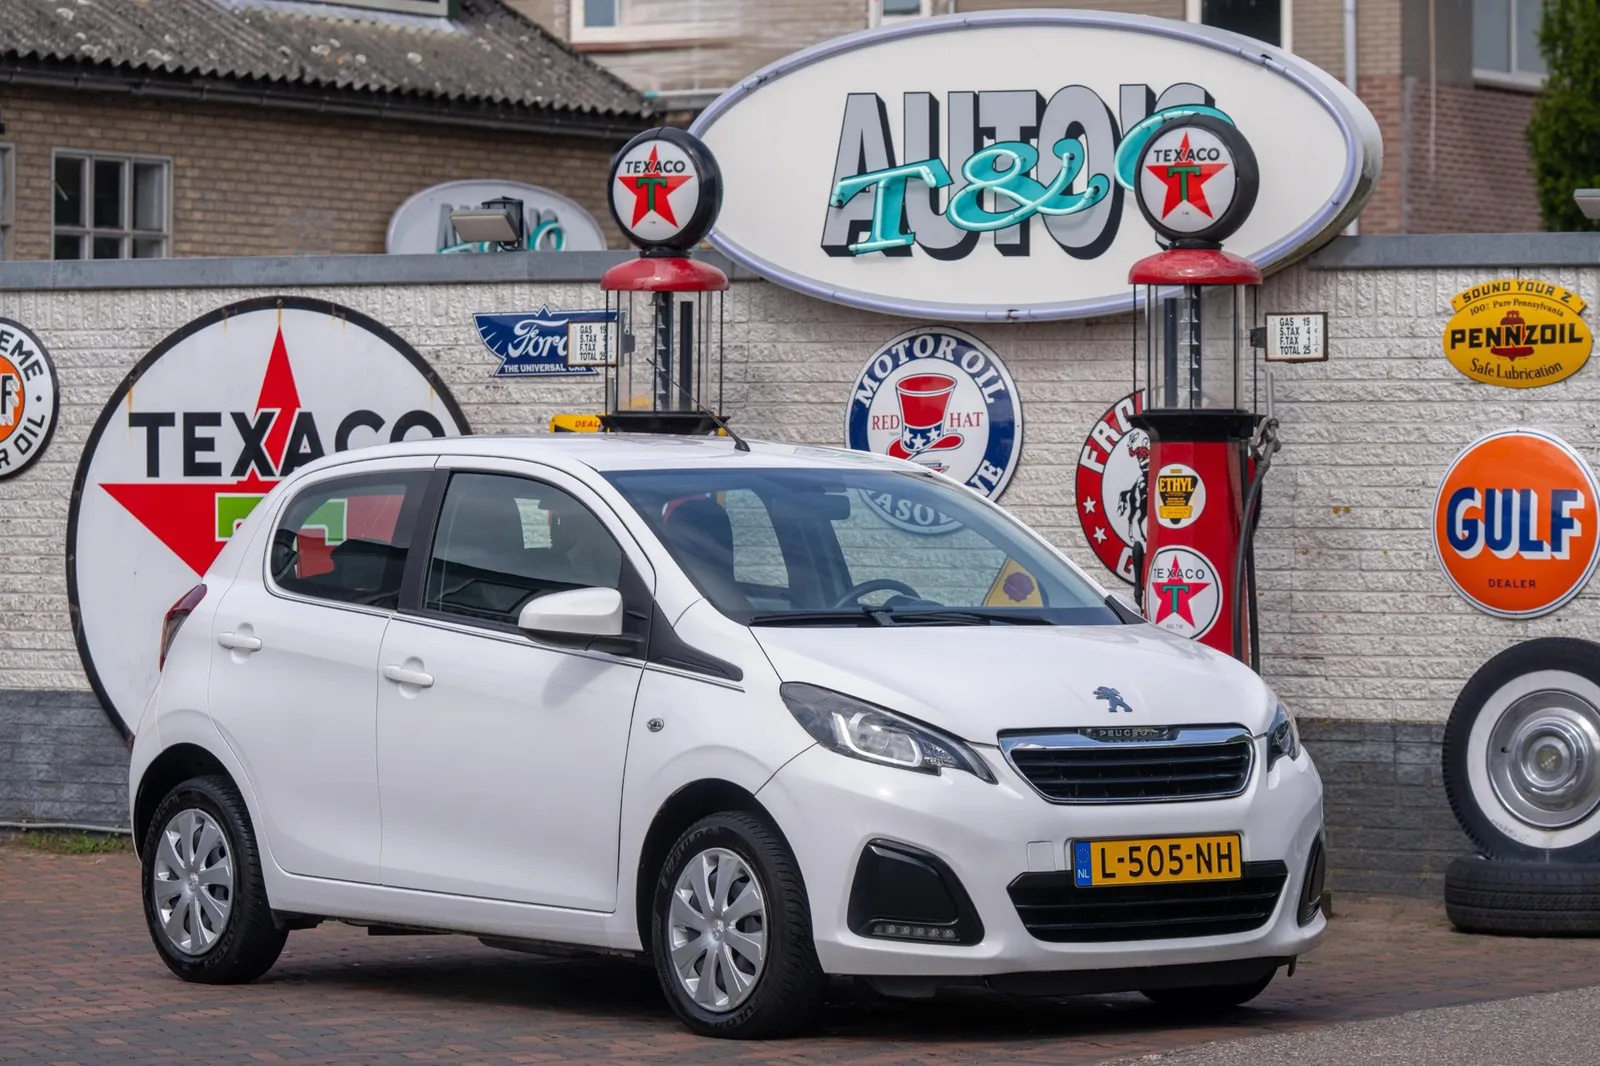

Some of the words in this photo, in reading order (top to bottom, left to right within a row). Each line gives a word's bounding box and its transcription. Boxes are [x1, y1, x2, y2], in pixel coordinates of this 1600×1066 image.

[1153, 147, 1220, 163] TEXACO
[625, 160, 686, 174] TEXACO
[1462, 281, 1511, 304] SOUND
[1516, 281, 1555, 297] YOUR
[1560, 291, 1573, 304] Z
[1493, 300, 1511, 309] Pure
[1513, 298, 1564, 318] Pennsylvania
[1279, 316, 1294, 327] GAS
[1302, 316, 1311, 326] 19
[579, 324, 593, 334] GAS
[1279, 326, 1300, 336] S.TAX
[1279, 336, 1299, 346] F.TAX
[1450, 323, 1584, 350] PENNZOIL
[579, 352, 598, 361] TOTAL
[1279, 345, 1301, 355] TOTAL
[1303, 345, 1312, 355] 25
[503, 364, 519, 373] THE
[520, 363, 567, 373] UNIVERSAL
[855, 334, 958, 408] MOTOR
[960, 349, 1006, 404] OIL
[1470, 357, 1495, 378] Safe
[1496, 361, 1563, 381] Lubrication
[872, 413, 900, 431] RED
[949, 411, 984, 429] HAT
[13, 414, 46, 456] OIL
[1159, 477, 1195, 492] ETHYL
[1446, 486, 1585, 561] GULF
[1153, 568, 1205, 580] TEXACO
[1488, 578, 1537, 588] DEALER
[1099, 728, 1153, 738] PEUGEOT
[1100, 841, 1233, 879] L-505-NH
[1077, 868, 1090, 879] NL
